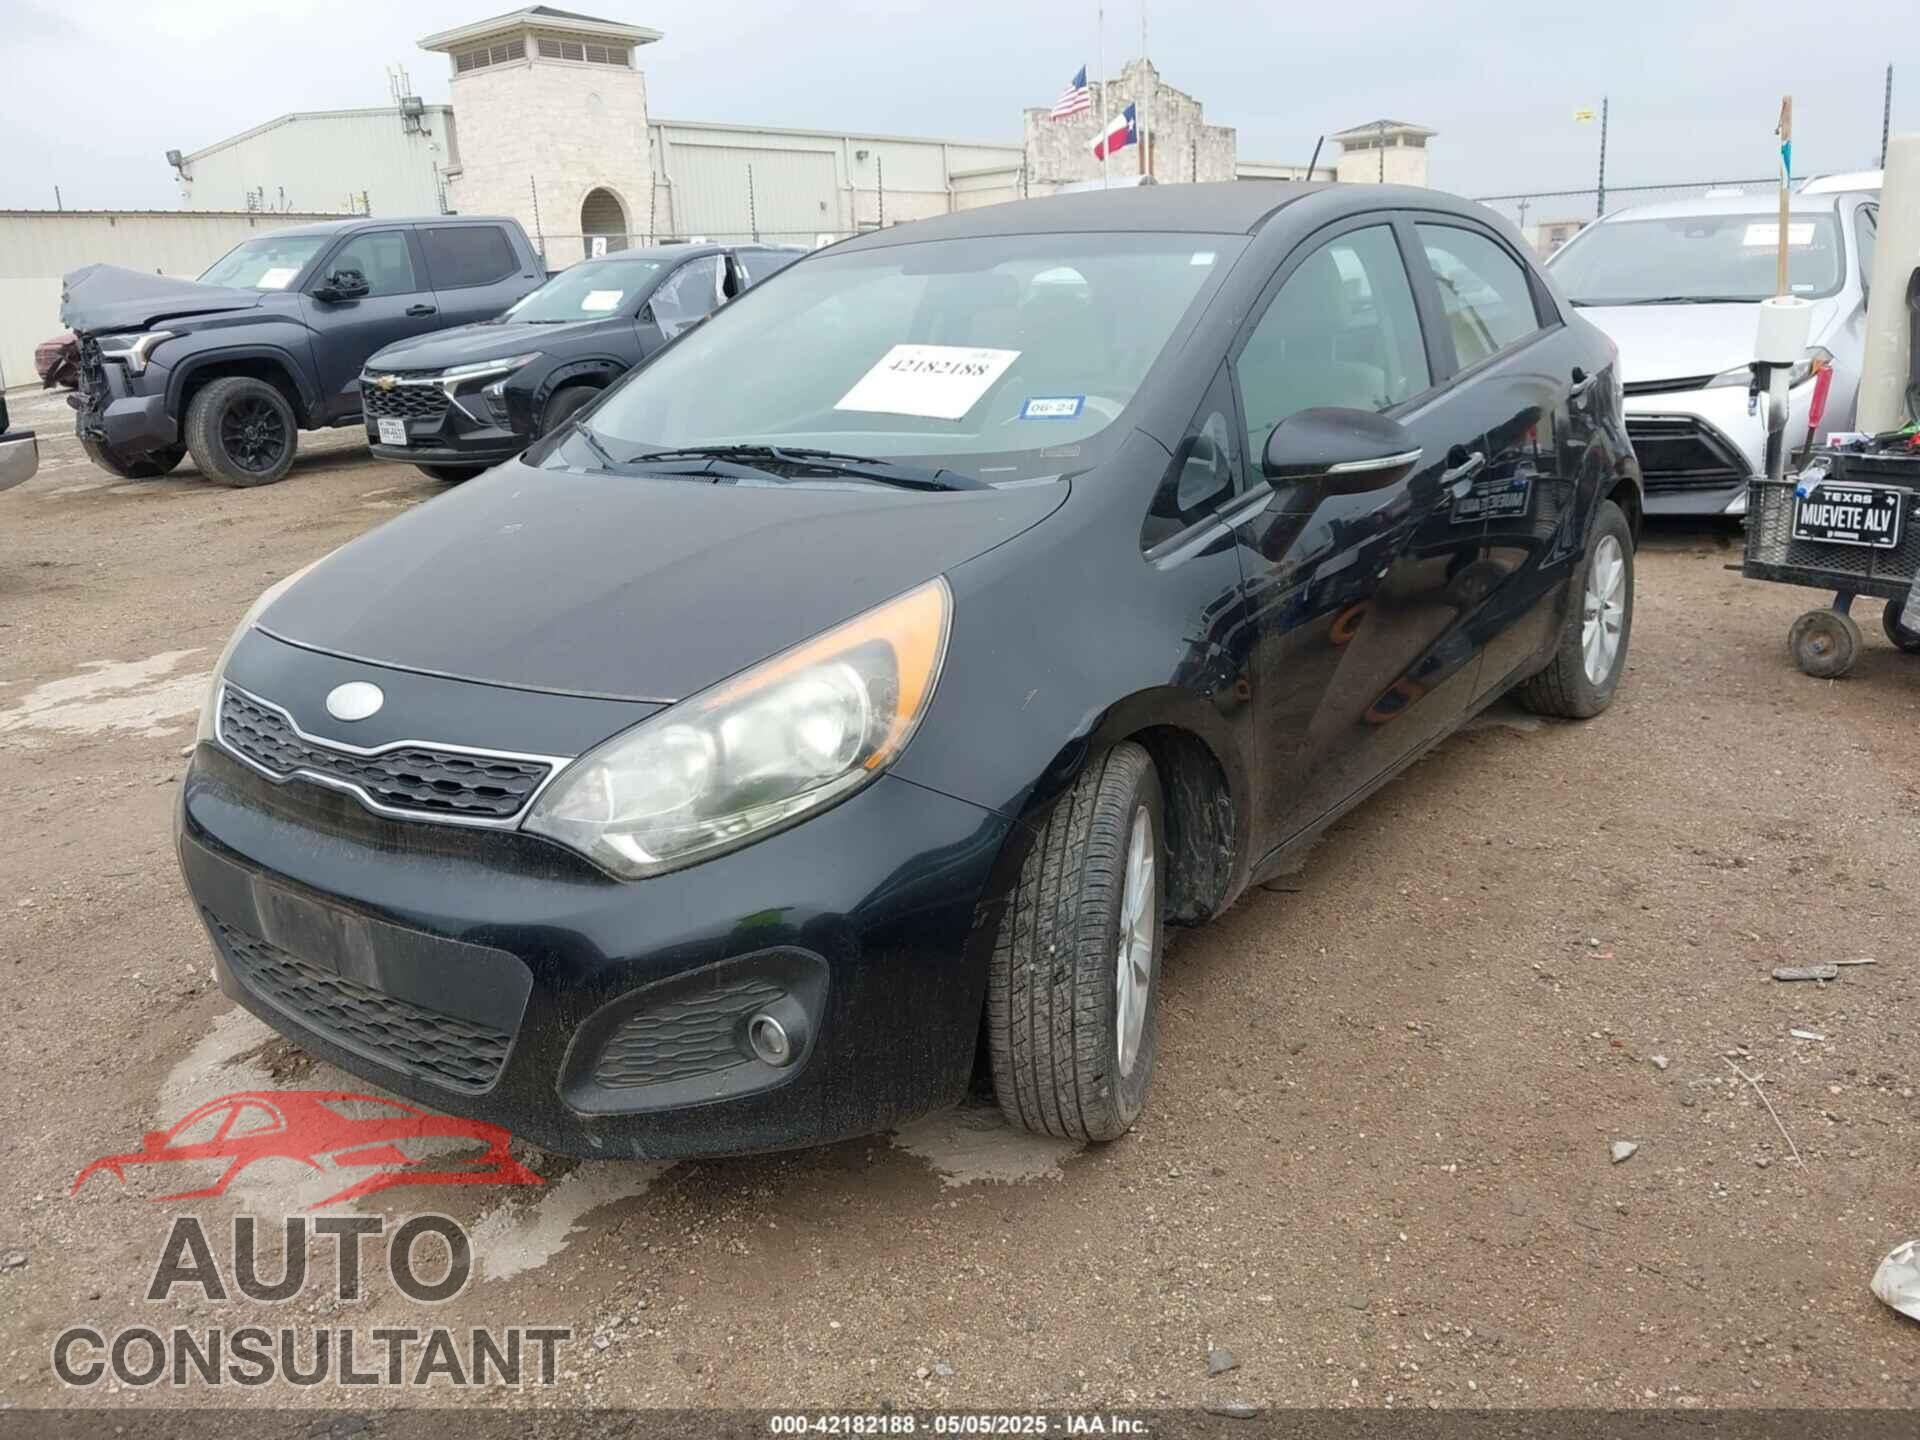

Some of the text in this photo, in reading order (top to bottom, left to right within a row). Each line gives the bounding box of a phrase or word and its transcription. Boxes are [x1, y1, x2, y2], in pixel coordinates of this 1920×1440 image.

[889, 359, 990, 376] 42182188
[1823, 492, 1872, 504] TEXAS
[1801, 503, 1892, 532] MUEVETE ALV
